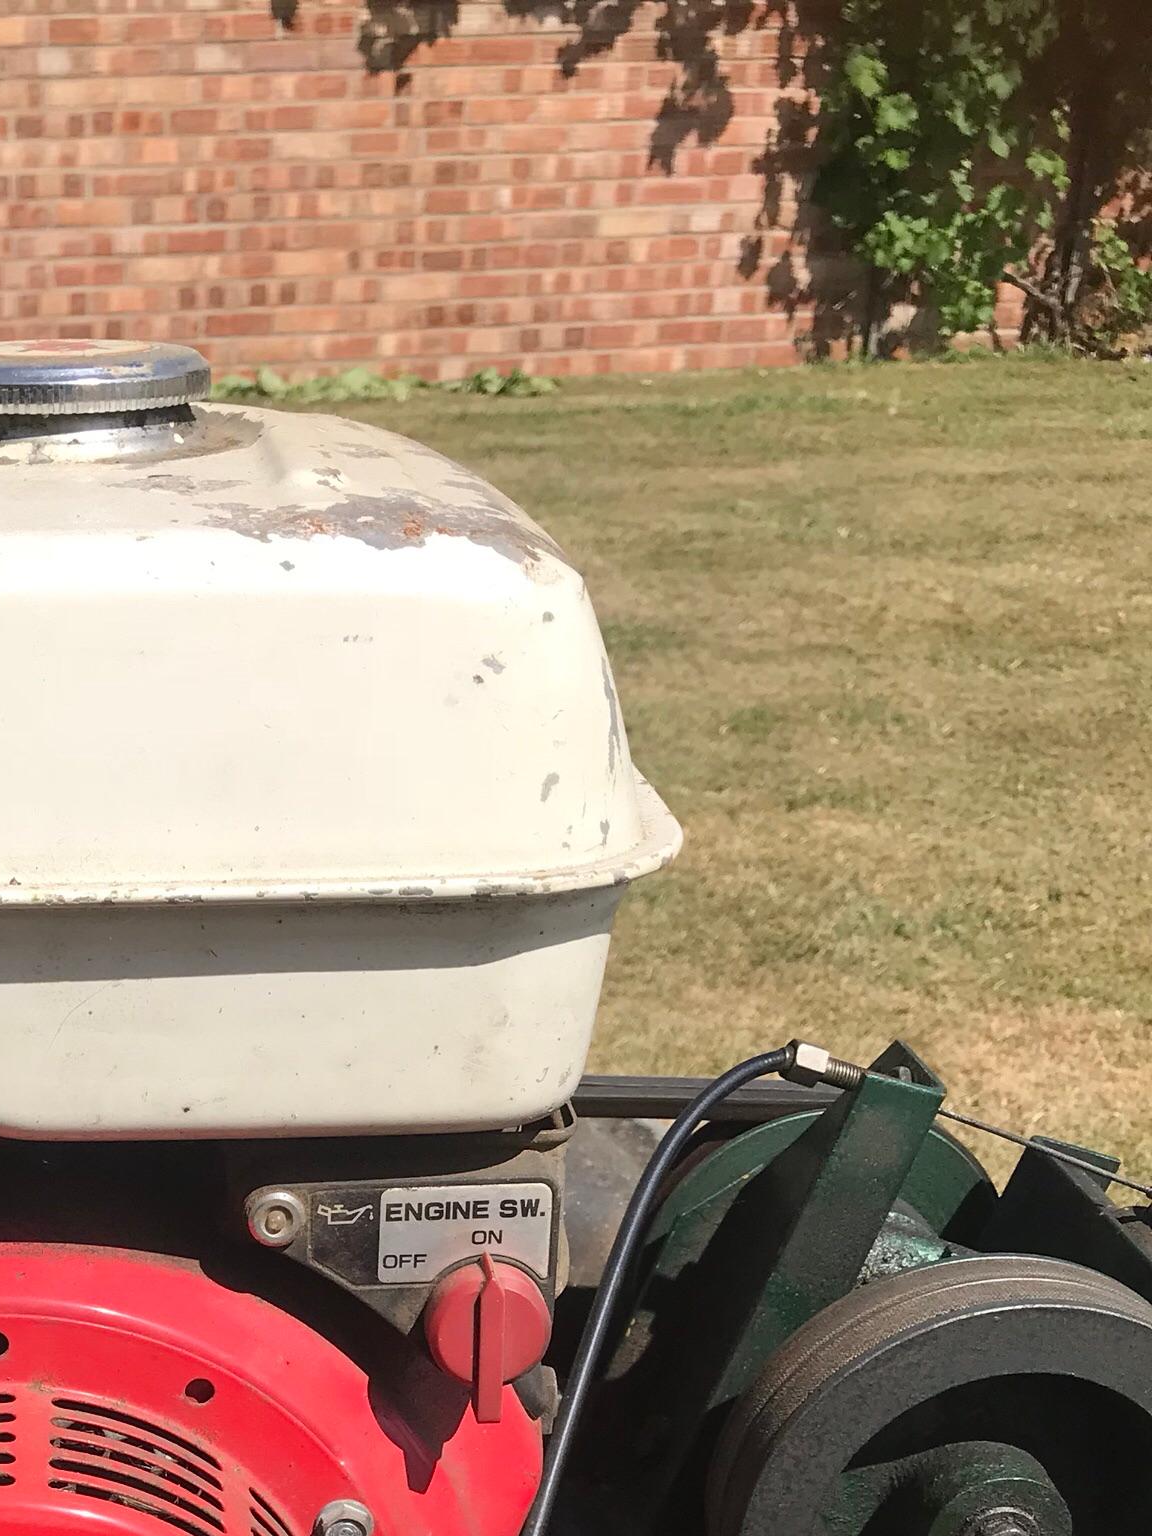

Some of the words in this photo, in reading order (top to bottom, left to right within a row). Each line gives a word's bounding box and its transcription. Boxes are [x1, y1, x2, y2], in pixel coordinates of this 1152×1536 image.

[385, 1201, 489, 1222] ENGINE
[499, 1199, 546, 1218] SW.
[471, 1230, 503, 1244] ON
[382, 1254, 427, 1269] OFF
